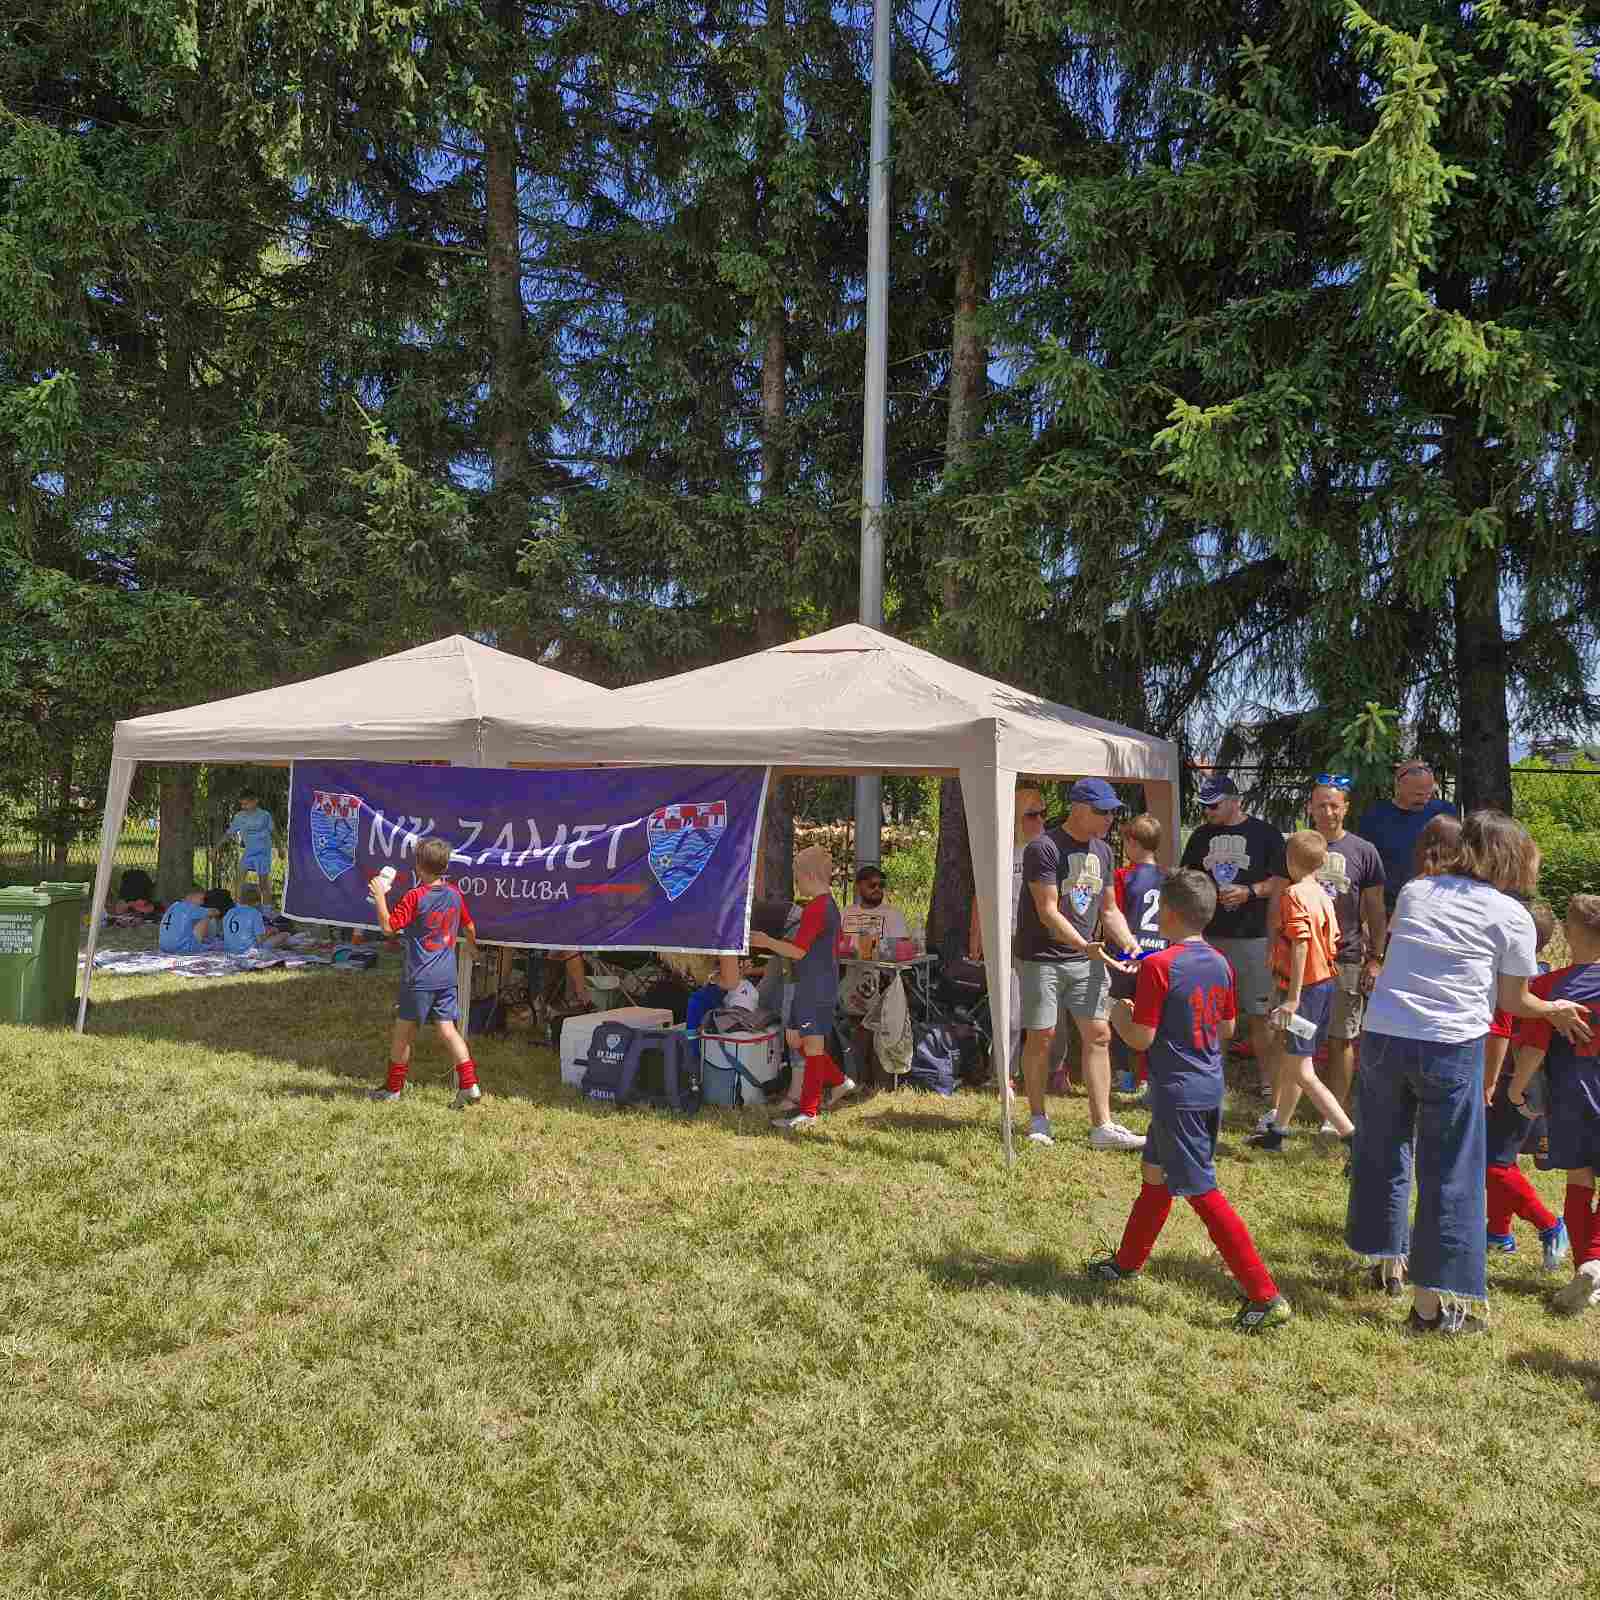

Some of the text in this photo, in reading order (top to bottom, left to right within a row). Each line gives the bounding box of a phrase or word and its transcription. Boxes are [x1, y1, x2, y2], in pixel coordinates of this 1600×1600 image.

[369, 811, 641, 871] NK ZAMET
[457, 876, 488, 897] OD
[495, 878, 569, 900] KLUBA
[161, 913, 172, 931] 4
[229, 915, 240, 934] 6
